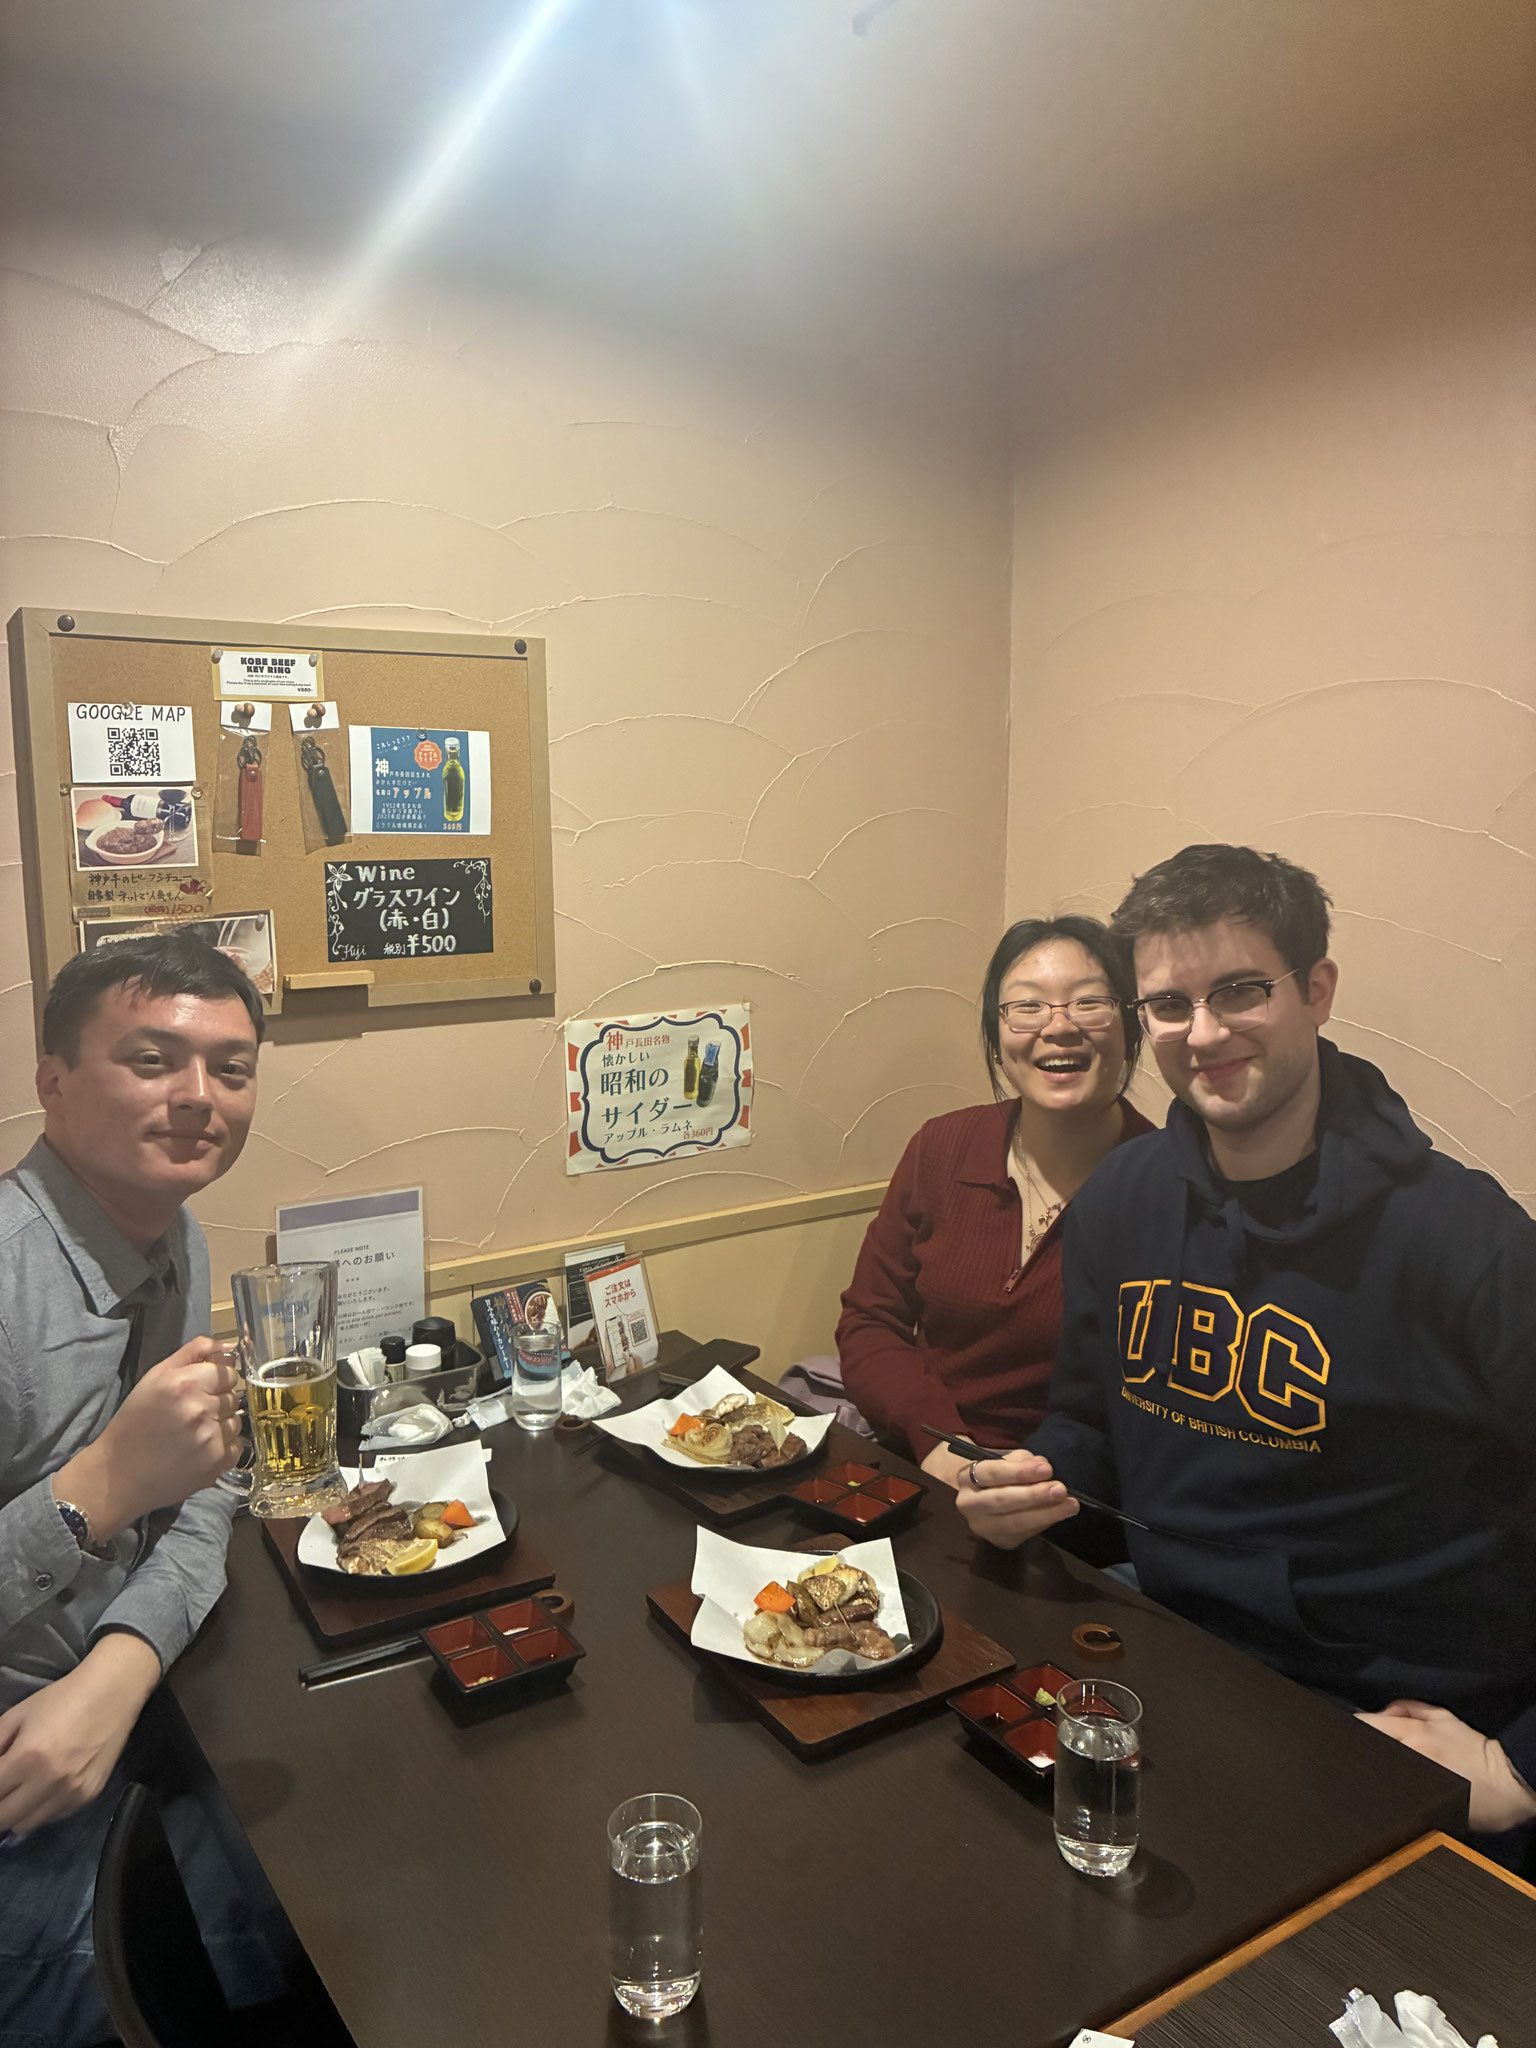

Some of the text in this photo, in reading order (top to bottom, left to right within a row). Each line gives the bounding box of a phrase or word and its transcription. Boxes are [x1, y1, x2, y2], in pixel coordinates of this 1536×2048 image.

[240, 656, 296, 667] KOBE BEEF
[246, 665, 291, 674] KEY RING
[151, 706, 186, 722] MAP
[355, 865, 416, 883] Wine
[352, 886, 461, 910] グラスワイン
[406, 933, 457, 956] ¥500
[606, 1031, 671, 1052] 神戸長田名物
[602, 1051, 650, 1068] 懐かしい
[600, 1067, 669, 1097] 昭和の
[601, 1096, 693, 1130] サイダー
[604, 1119, 694, 1145] アップル・ラムネ
[682, 1126, 714, 1140] 各360円
[604, 1278, 632, 1296] ご注文は
[604, 1288, 637, 1309] スマホから
[1118, 1278, 1331, 1437] UBC
[1121, 1385, 1322, 1454] UNIVERSITY OF BRITISH COLUMBIA
